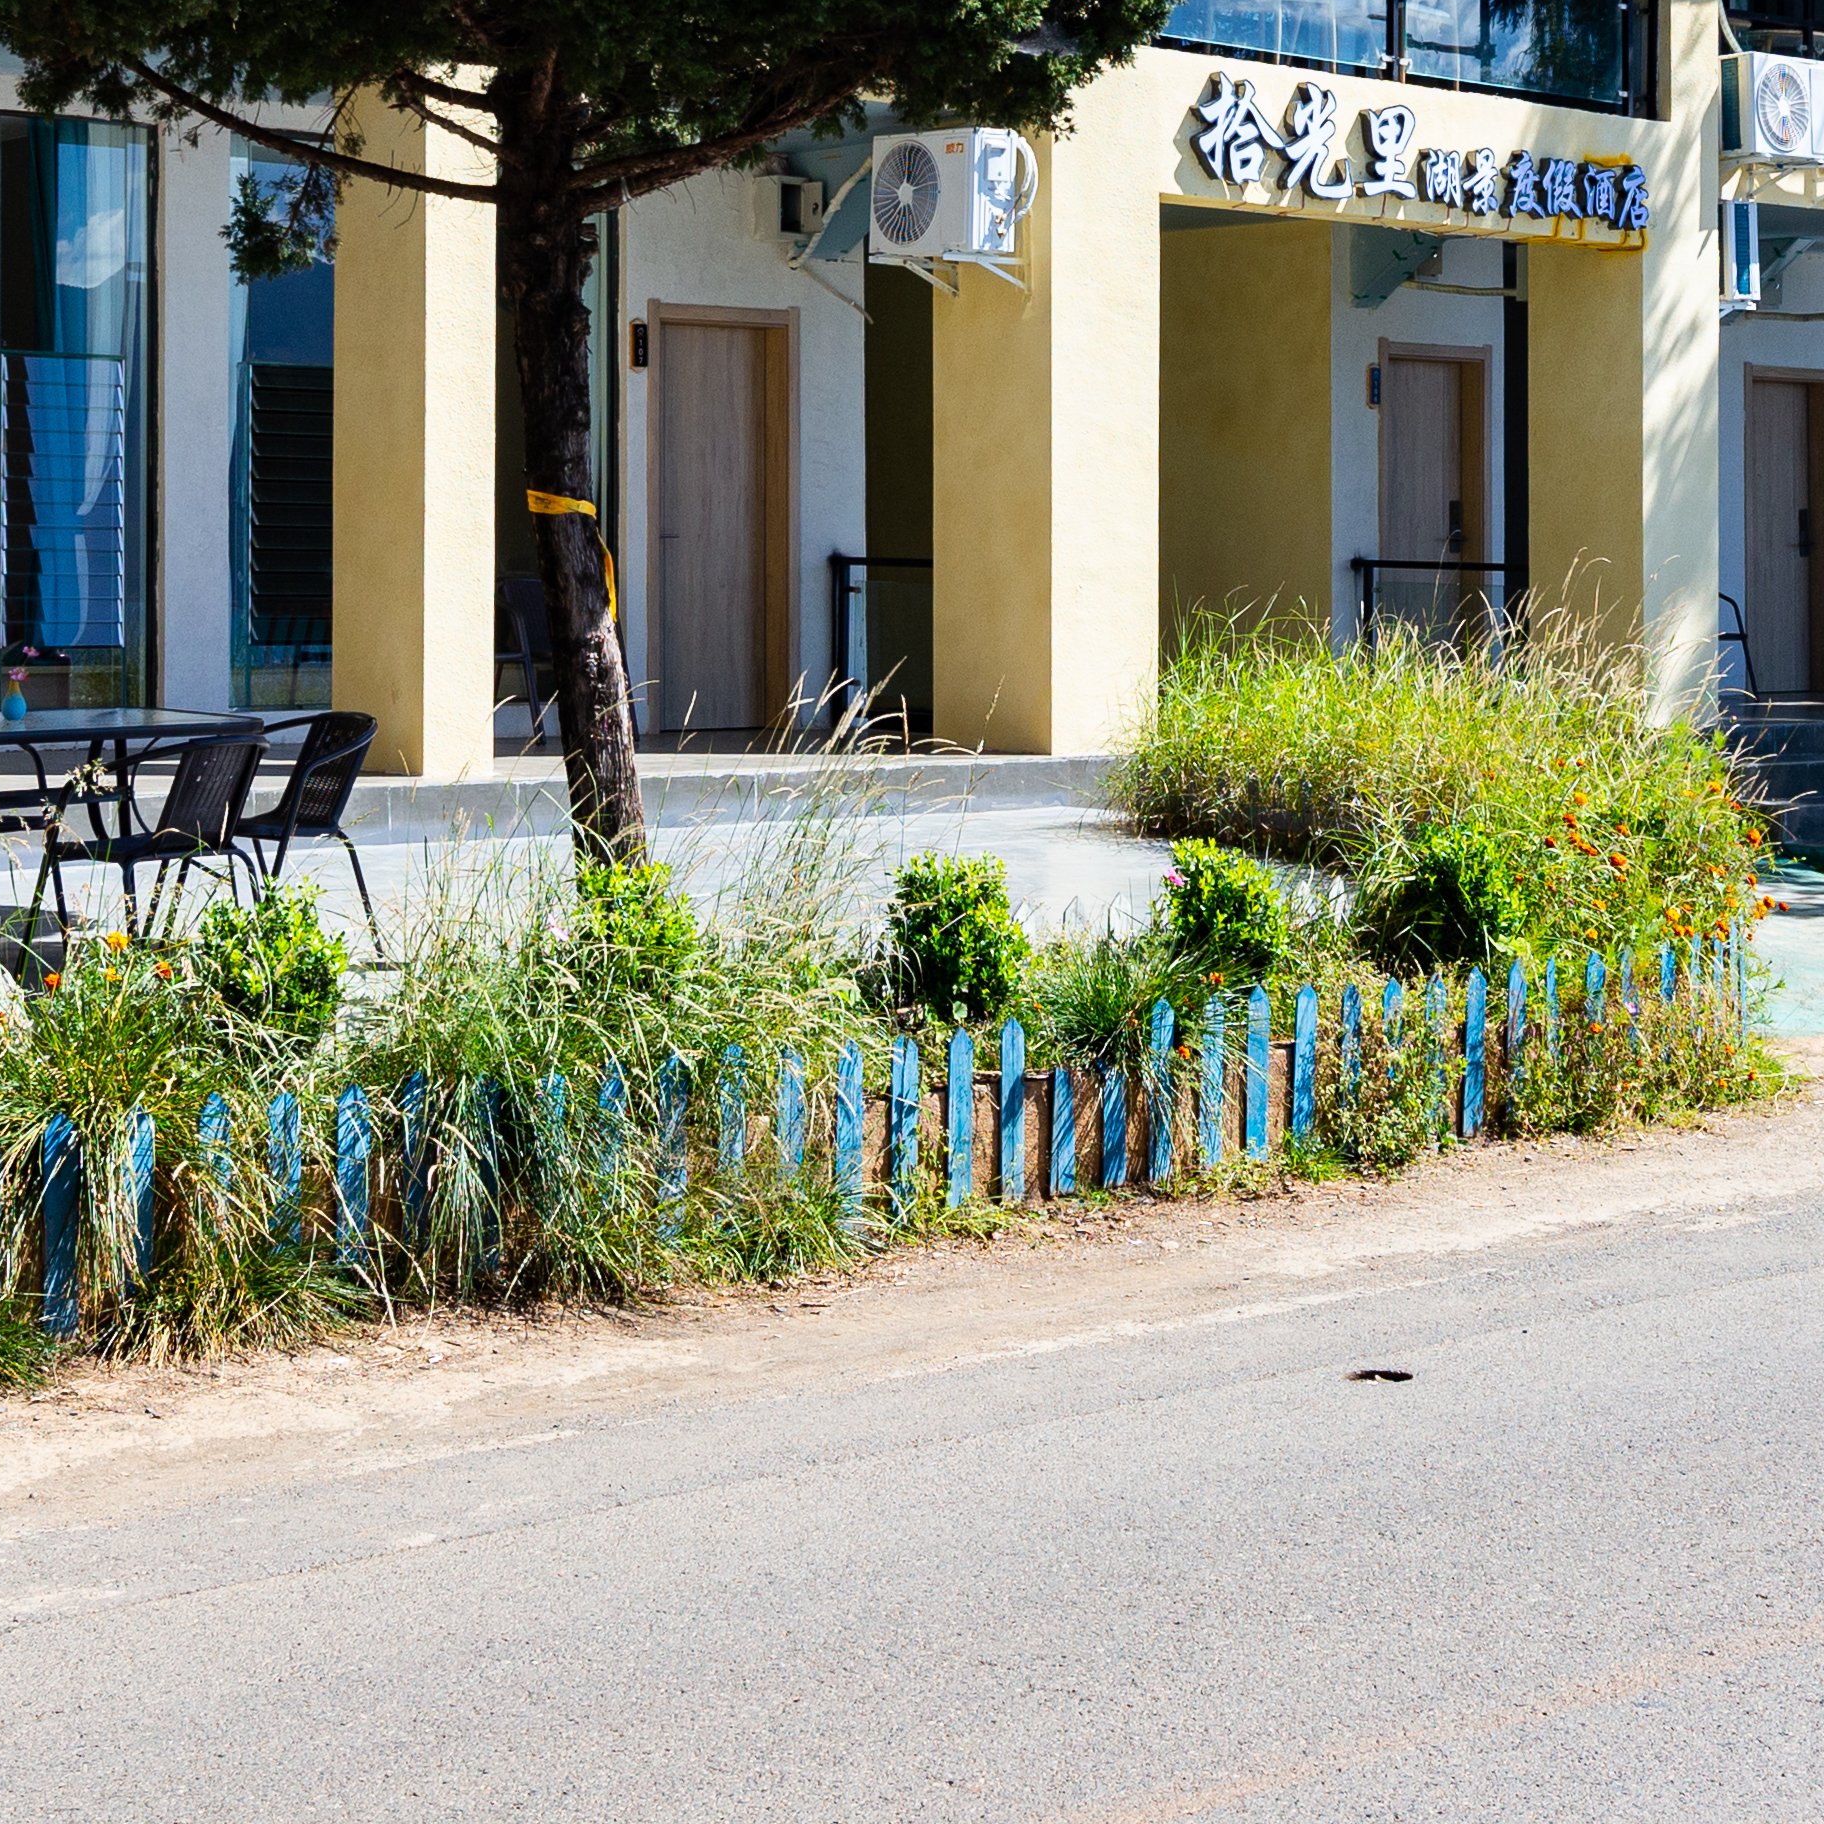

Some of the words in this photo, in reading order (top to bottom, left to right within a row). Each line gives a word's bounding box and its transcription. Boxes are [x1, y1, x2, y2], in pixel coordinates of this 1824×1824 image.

[1197, 71, 1417, 200] 拾光里
[1424, 147, 1650, 230] 湖景度假酒店
